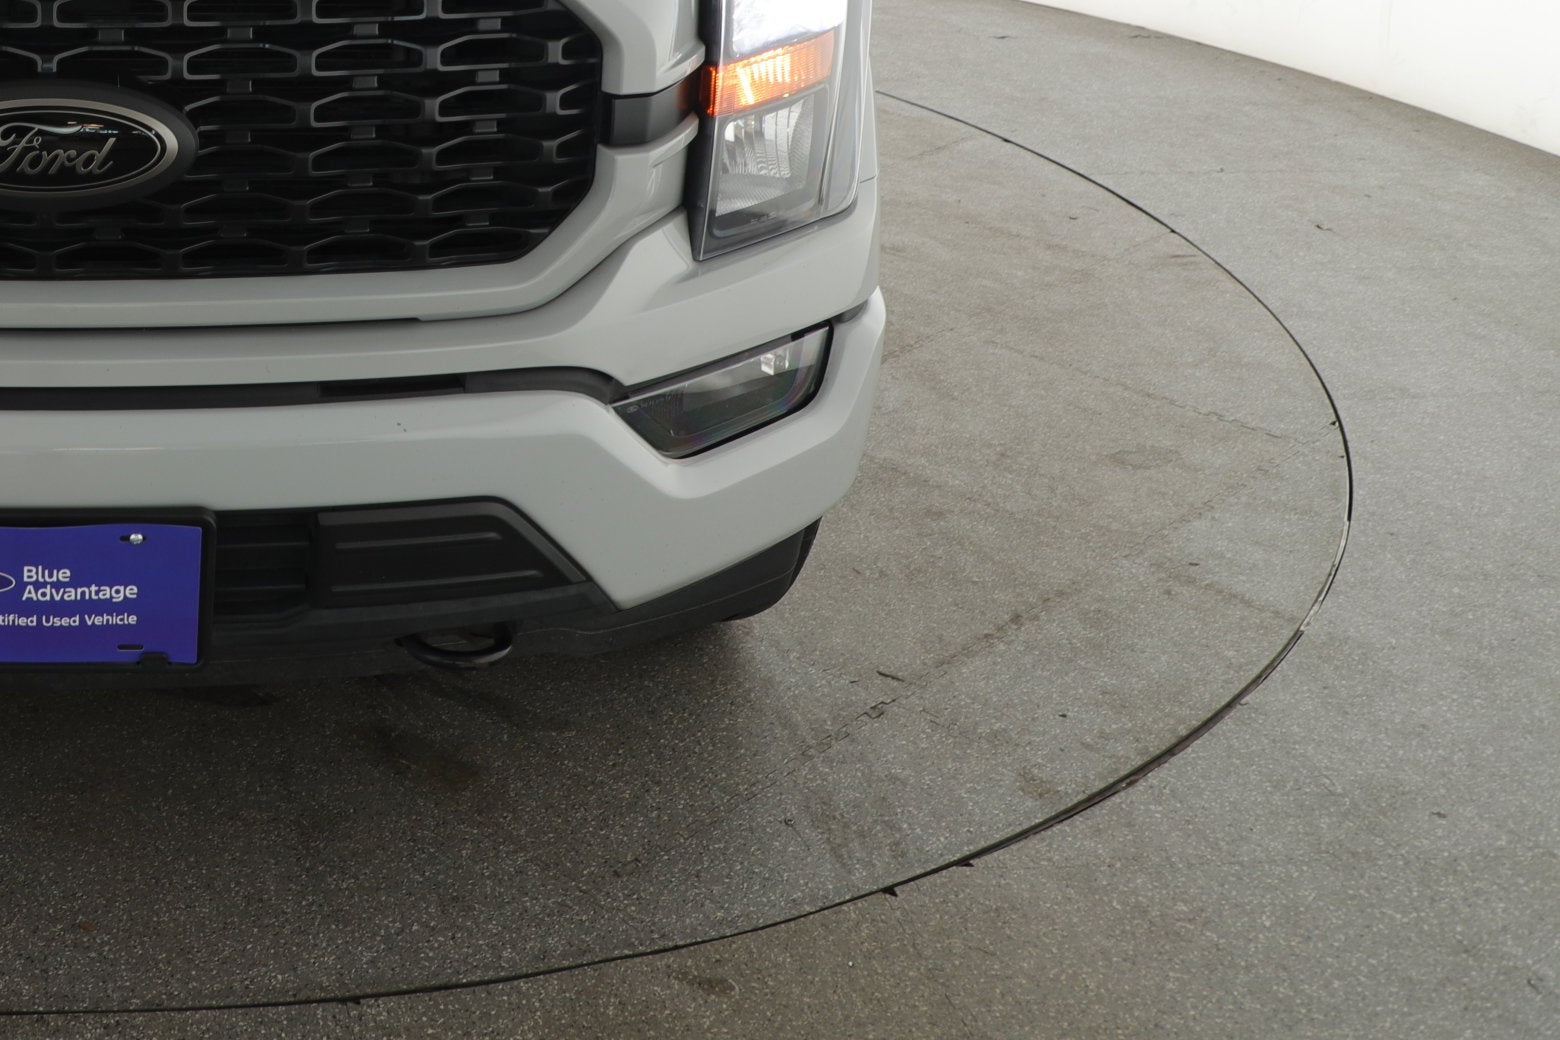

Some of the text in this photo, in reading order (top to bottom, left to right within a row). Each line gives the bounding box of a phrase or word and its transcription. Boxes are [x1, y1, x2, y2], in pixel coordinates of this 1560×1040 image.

[23, 566, 71, 582] Blue
[22, 584, 138, 602] Advantage
[42, 614, 80, 626] Used
[84, 613, 138, 626] Vehicle
